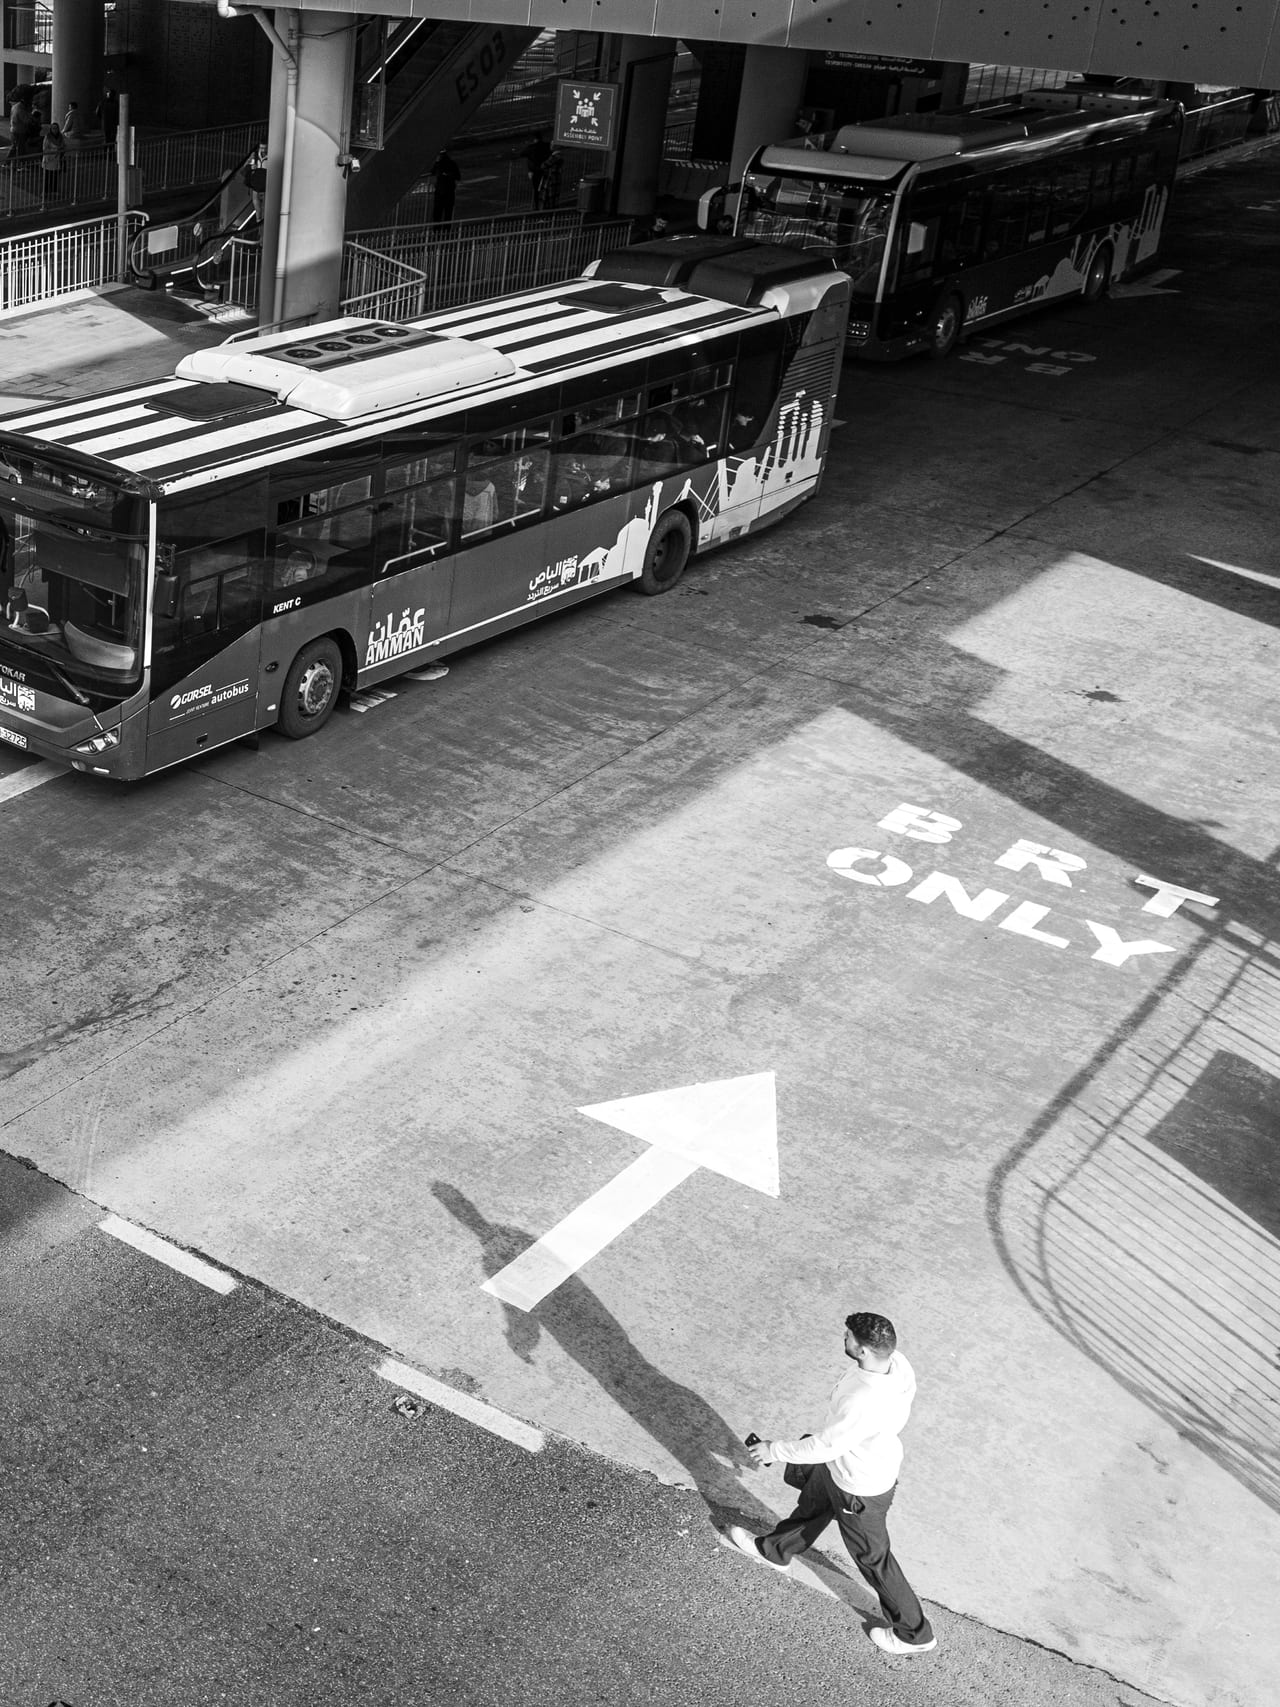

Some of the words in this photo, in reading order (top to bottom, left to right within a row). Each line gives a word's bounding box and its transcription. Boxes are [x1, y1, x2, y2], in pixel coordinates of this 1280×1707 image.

[529, 561, 562, 591] الباص
[273, 599, 295, 614] KENT
[295, 596, 302, 606] C
[365, 626, 424, 666] AMMAN
[211, 683, 249, 705] autobus
[876, 802, 1221, 918] BRT
[825, 846, 1177, 968] ONLY
